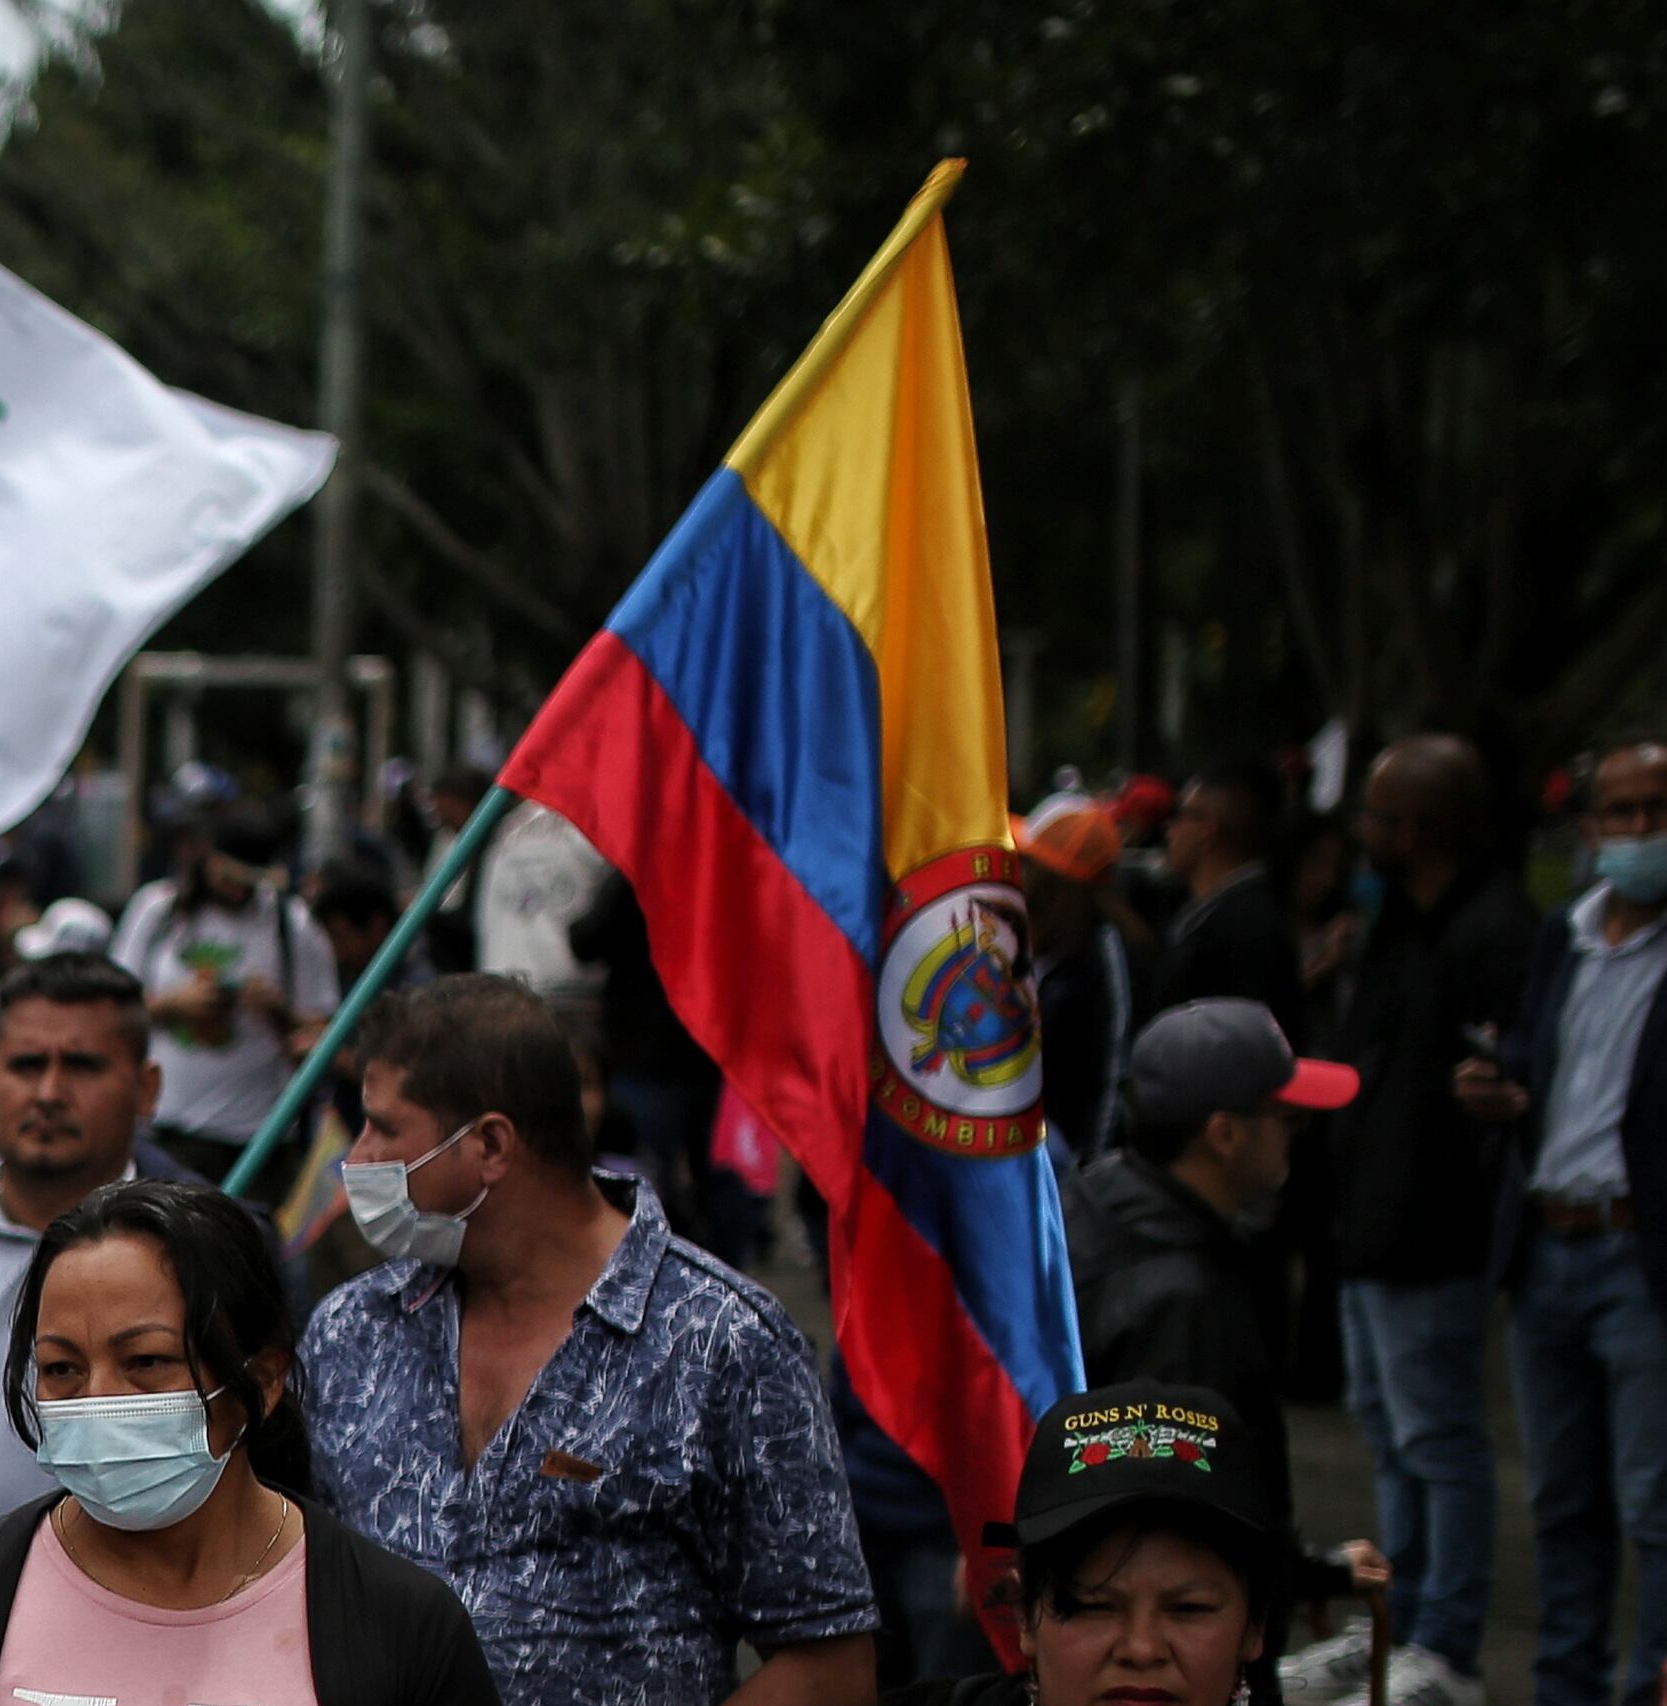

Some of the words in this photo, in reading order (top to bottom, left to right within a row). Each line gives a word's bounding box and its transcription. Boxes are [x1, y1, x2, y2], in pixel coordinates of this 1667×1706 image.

[1064, 1407, 1120, 1430] GUNS
[1124, 1403, 1147, 1419] N'
[1155, 1404, 1218, 1431] ROSES
